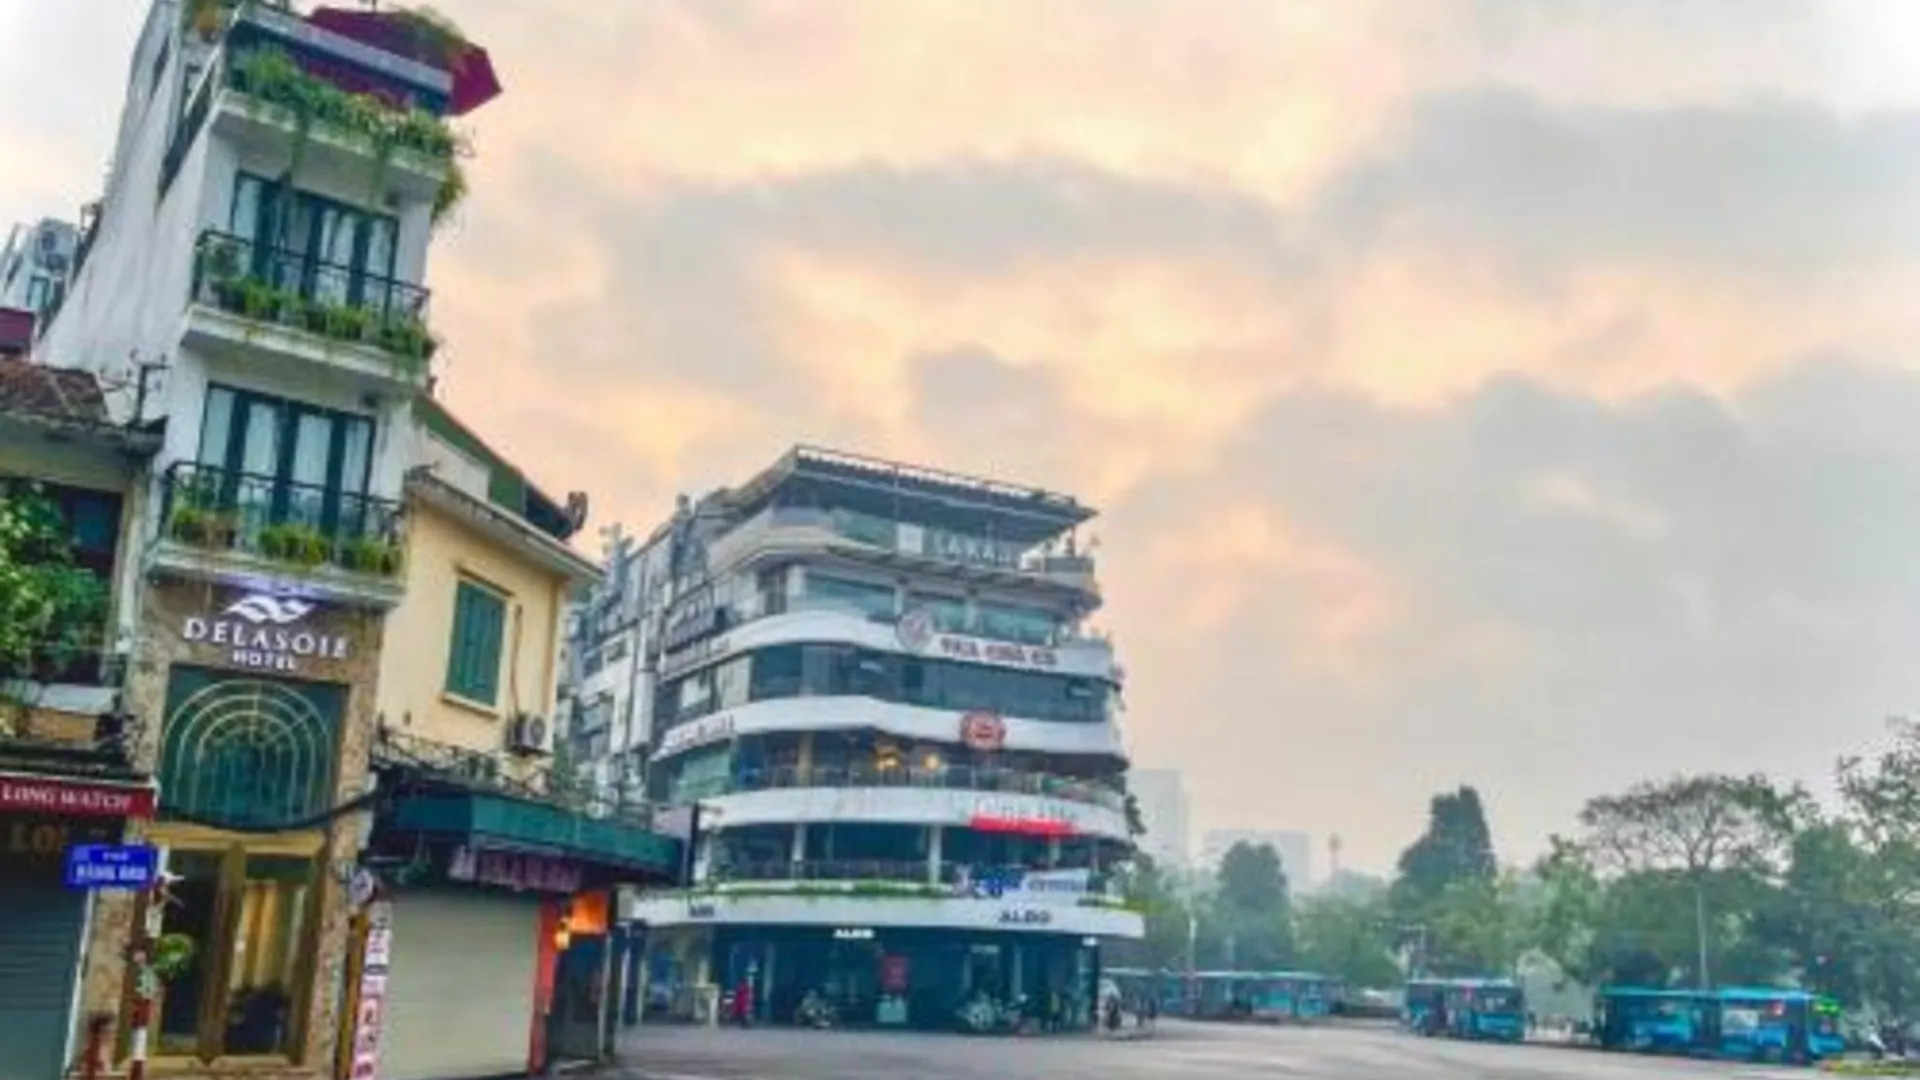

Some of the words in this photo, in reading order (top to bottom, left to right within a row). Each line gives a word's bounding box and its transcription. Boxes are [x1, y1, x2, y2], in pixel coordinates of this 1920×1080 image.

[183, 617, 348, 658] DELASOIE
[233, 650, 296, 670] HOTEL
[2, 783, 54, 804] LONG
[60, 790, 132, 812] WATCH
[999, 909, 1052, 923] ALDO
